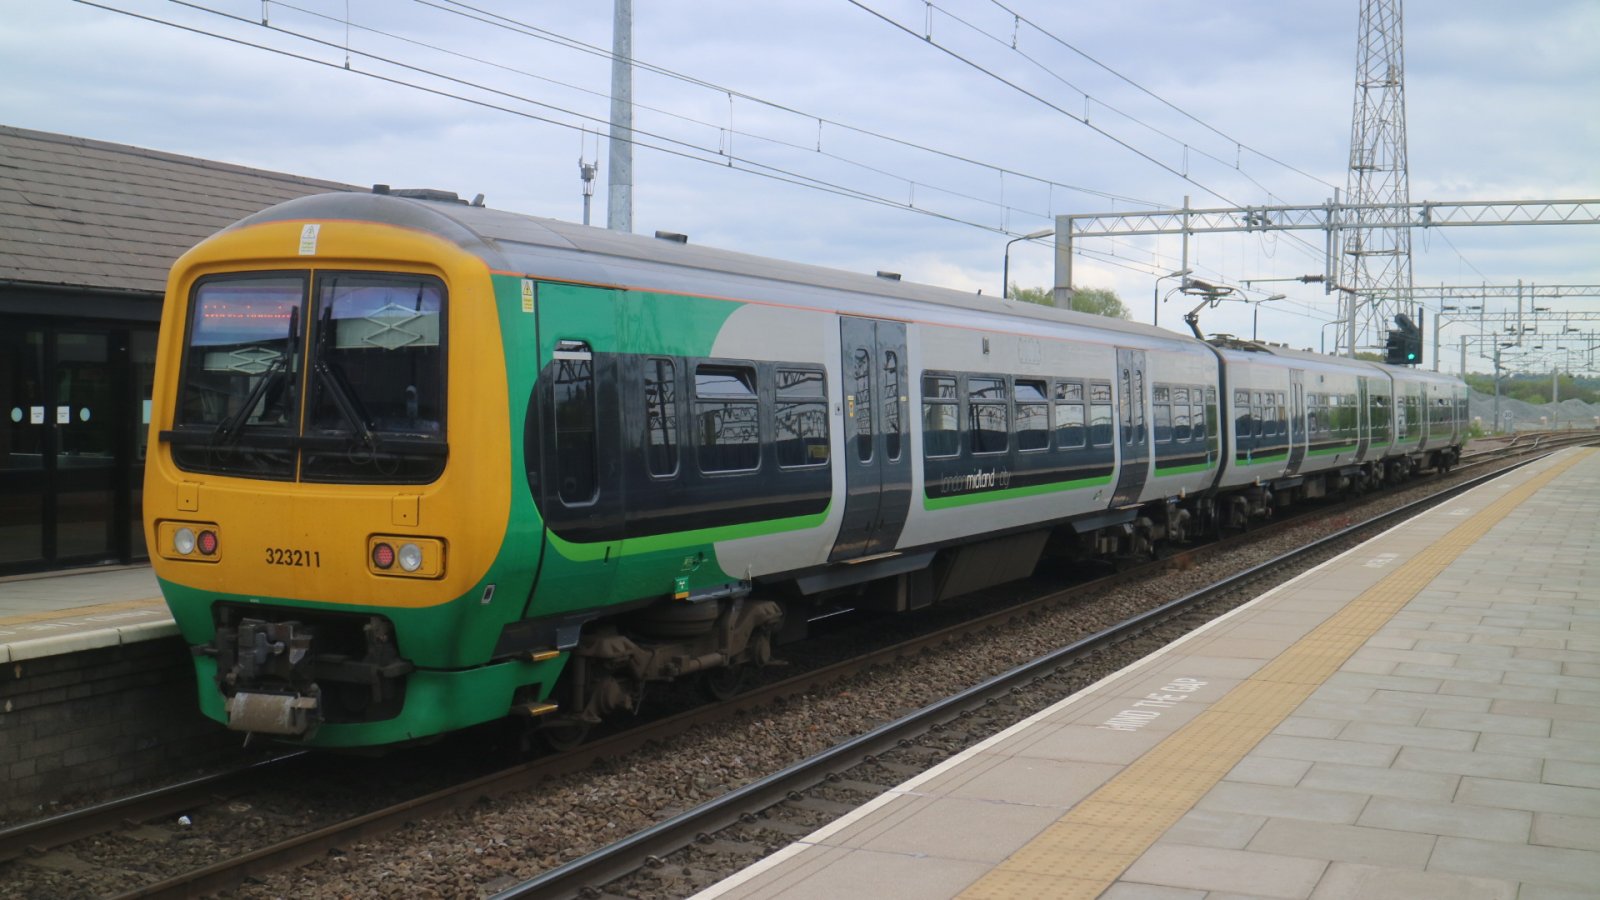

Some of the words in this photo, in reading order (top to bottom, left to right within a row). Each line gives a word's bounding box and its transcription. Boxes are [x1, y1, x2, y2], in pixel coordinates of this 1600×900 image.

[967, 467, 995, 490] midland
[265, 547, 320, 568] 323211
[1095, 709, 1161, 732] MIND
[1132, 692, 1188, 708] THE
[1160, 677, 1208, 693] GAP
